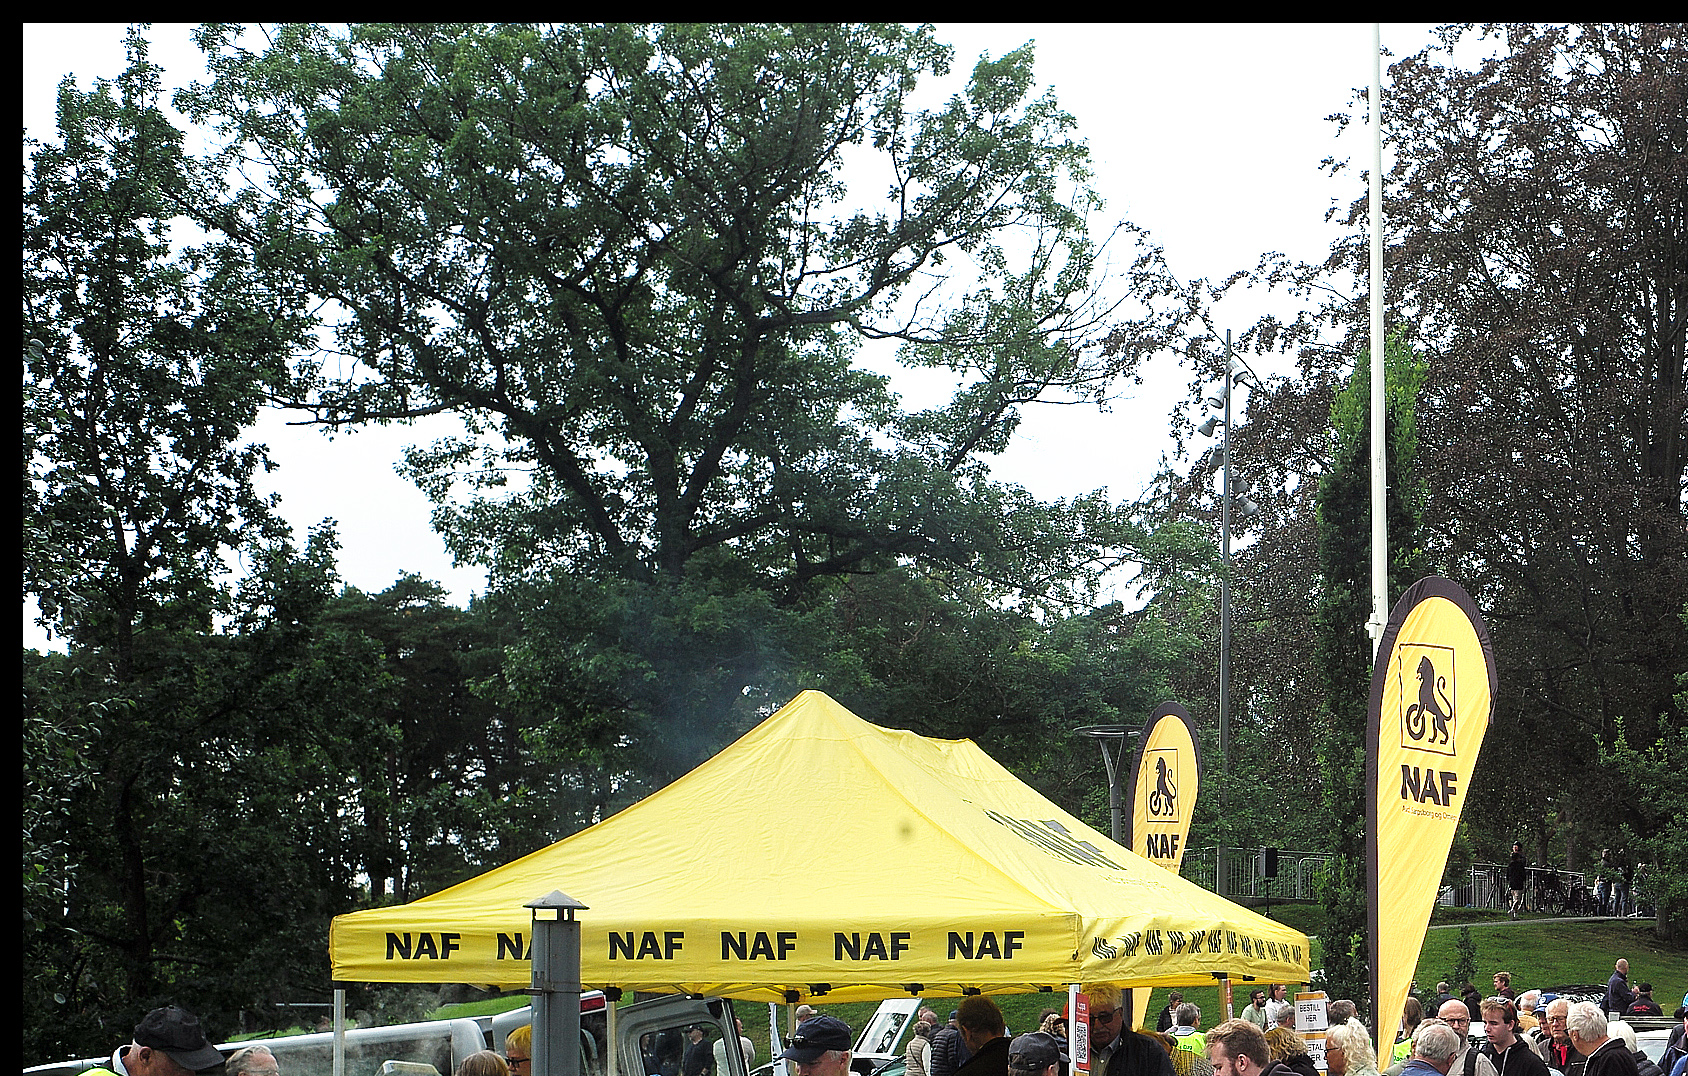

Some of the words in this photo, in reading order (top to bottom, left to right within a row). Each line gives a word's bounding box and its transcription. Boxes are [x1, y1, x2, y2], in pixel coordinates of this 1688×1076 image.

[1401, 764, 1457, 807] NAF
[1146, 833, 1180, 859] NAF
[386, 932, 462, 960] NAF
[496, 932, 532, 960] N
[608, 931, 685, 960] NAF
[721, 931, 797, 960] NAF
[834, 931, 910, 961] NAF
[947, 931, 1025, 960] NAF
[1299, 1003, 1321, 1013] BESTILL
[1305, 1014, 1318, 1023] HER
[1307, 1043, 1324, 1052] ETAL
[1310, 1053, 1321, 1062] ER
